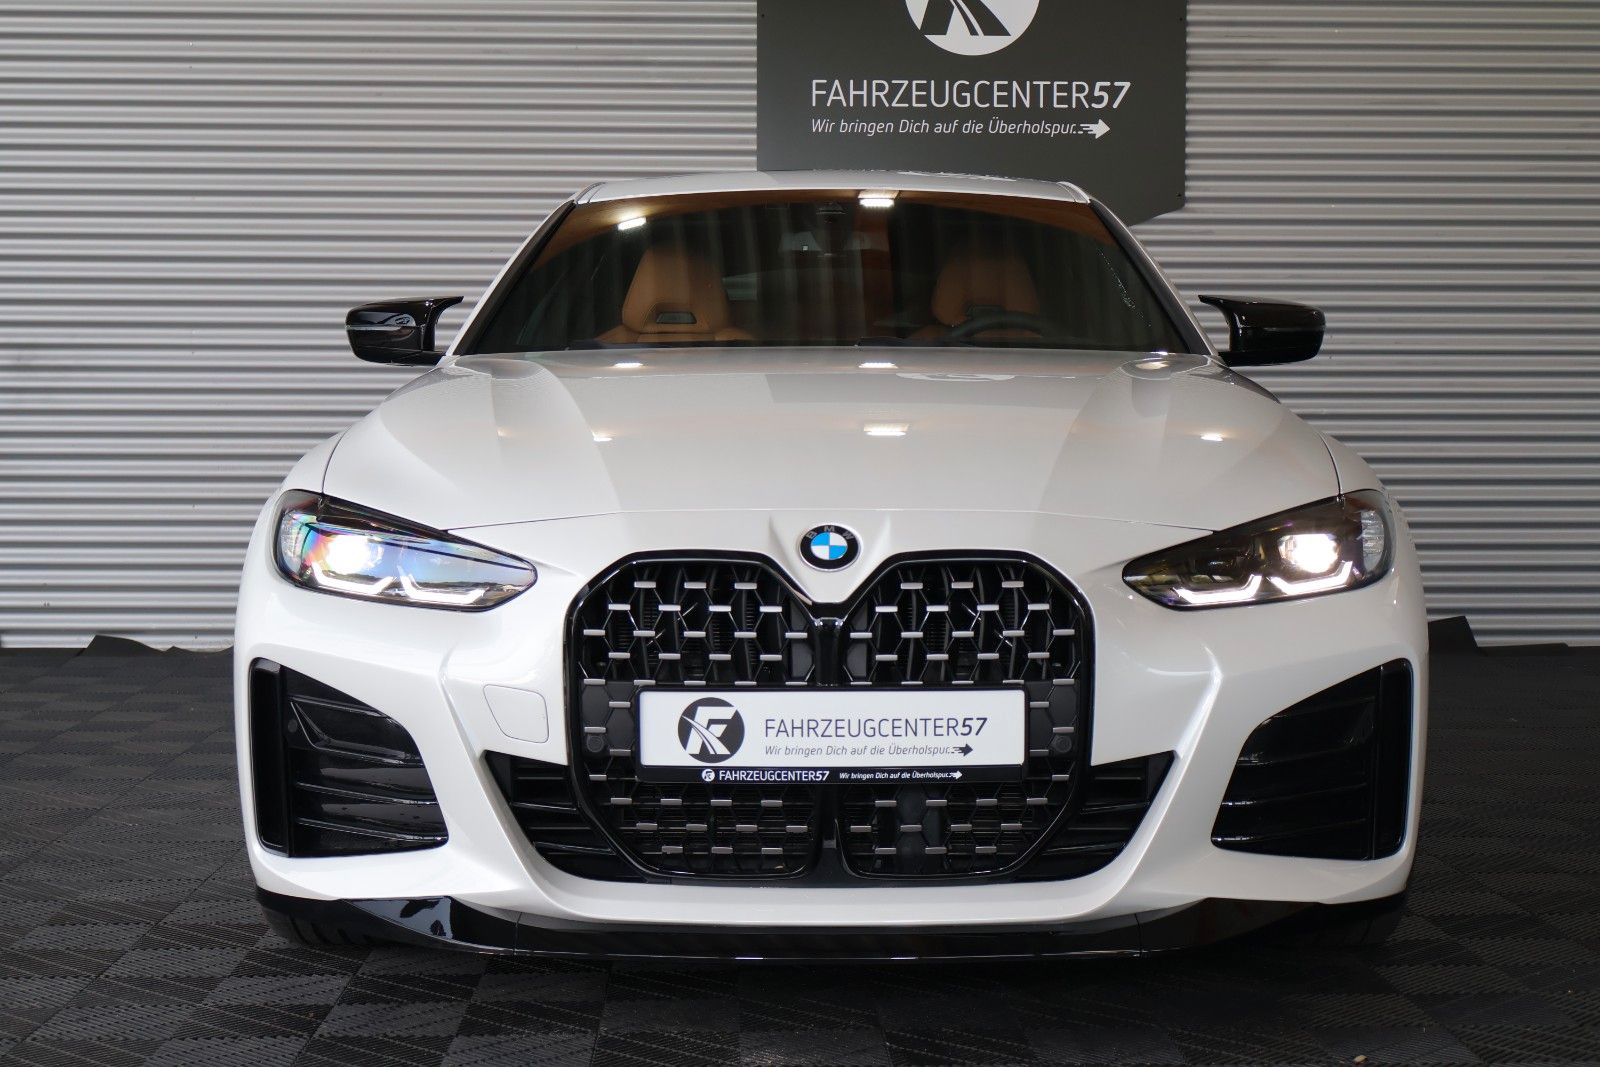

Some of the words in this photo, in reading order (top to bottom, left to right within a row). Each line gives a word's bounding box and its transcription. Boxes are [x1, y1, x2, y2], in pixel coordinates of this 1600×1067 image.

[811, 79, 1131, 109] FAHRZEUGCENTER57
[811, 118, 835, 133] Wir
[839, 118, 894, 137] bringen
[899, 119, 929, 134] Dich
[933, 119, 960, 134] auf
[962, 120, 984, 134] die
[804, 525, 855, 540] BMW
[765, 717, 988, 738] FAHRZEUGCENTER57
[765, 745, 782, 756] Wir
[784, 745, 823, 758] bringen
[826, 745, 848, 756] Dich
[850, 745, 868, 756] auf
[870, 744, 885, 755] die
[719, 770, 830, 781] FAHRZEUGCENTER57
[851, 771, 874, 781] bringen
[875, 771, 889, 779] Dich
[889, 771, 901, 779] auf
[901, 771, 911, 779] die
